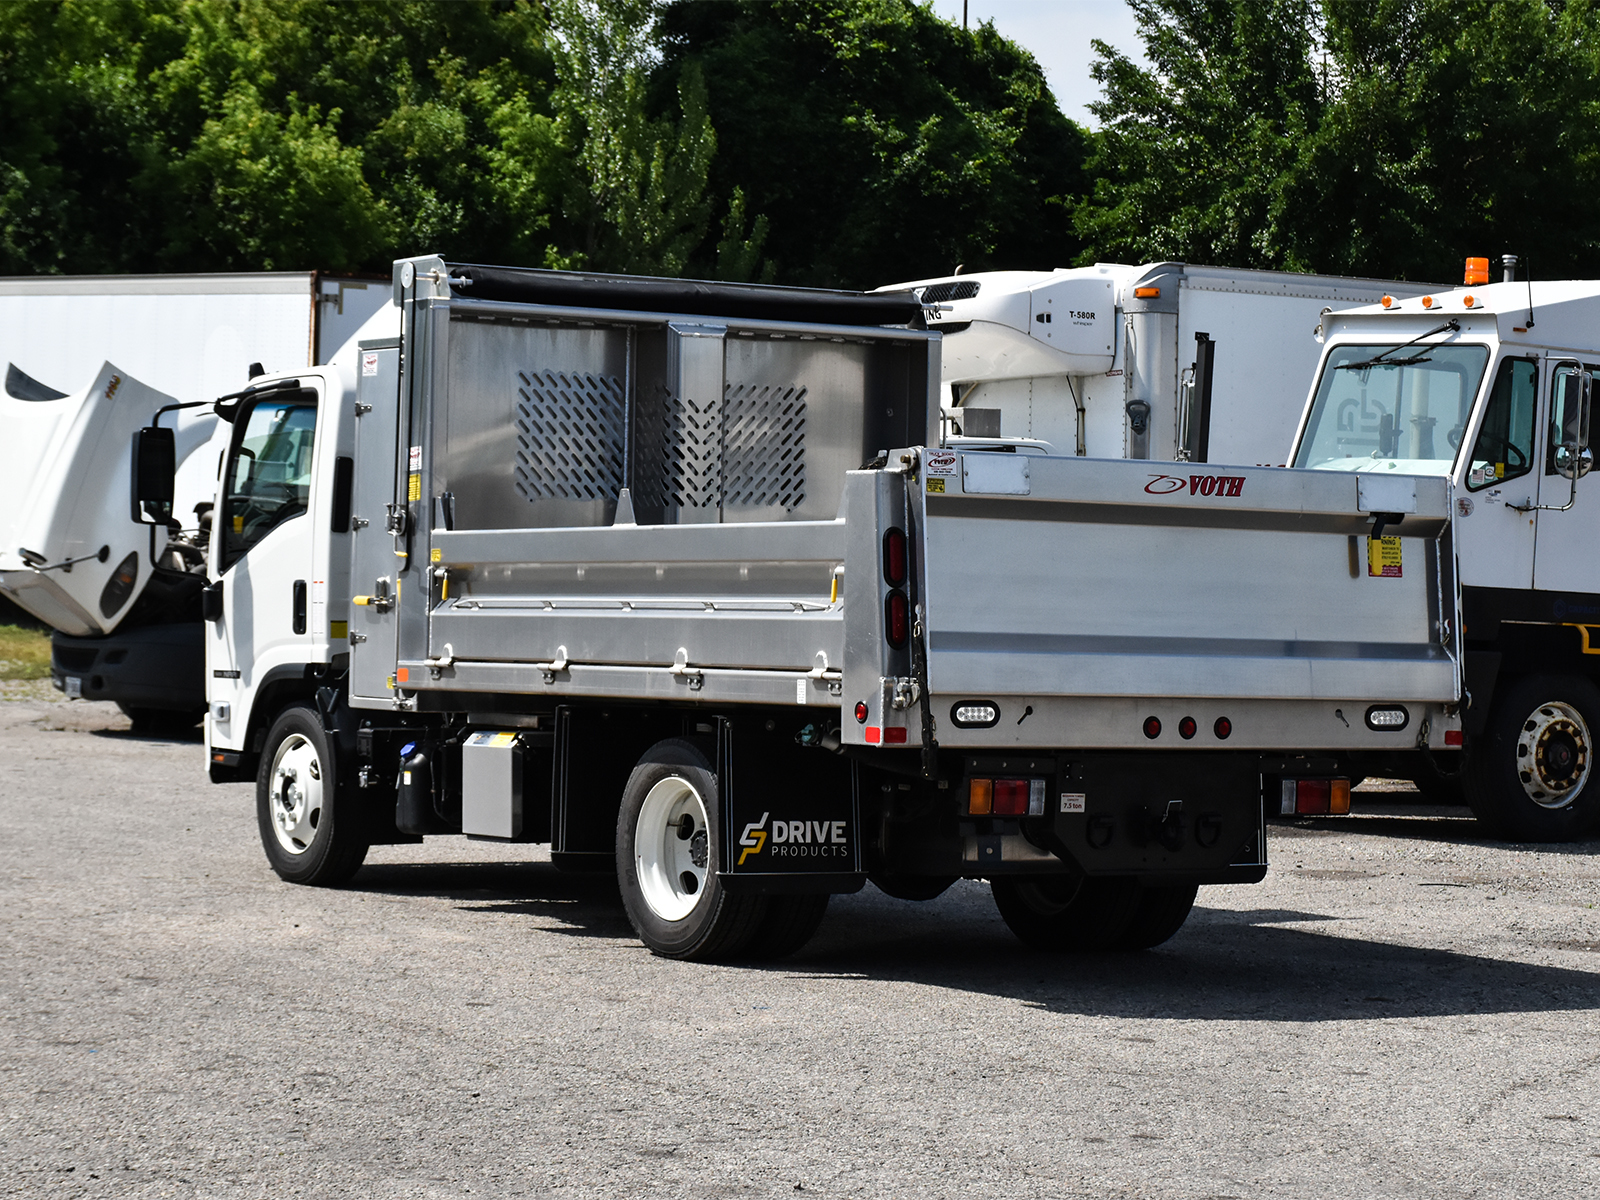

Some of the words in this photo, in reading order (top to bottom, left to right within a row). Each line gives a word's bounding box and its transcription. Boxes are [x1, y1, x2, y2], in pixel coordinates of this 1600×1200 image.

[1069, 310, 1096, 320] T-580R
[1189, 475, 1246, 497] VOTH
[772, 820, 847, 844] DRIVE
[771, 845, 848, 857] PRODUCTS
